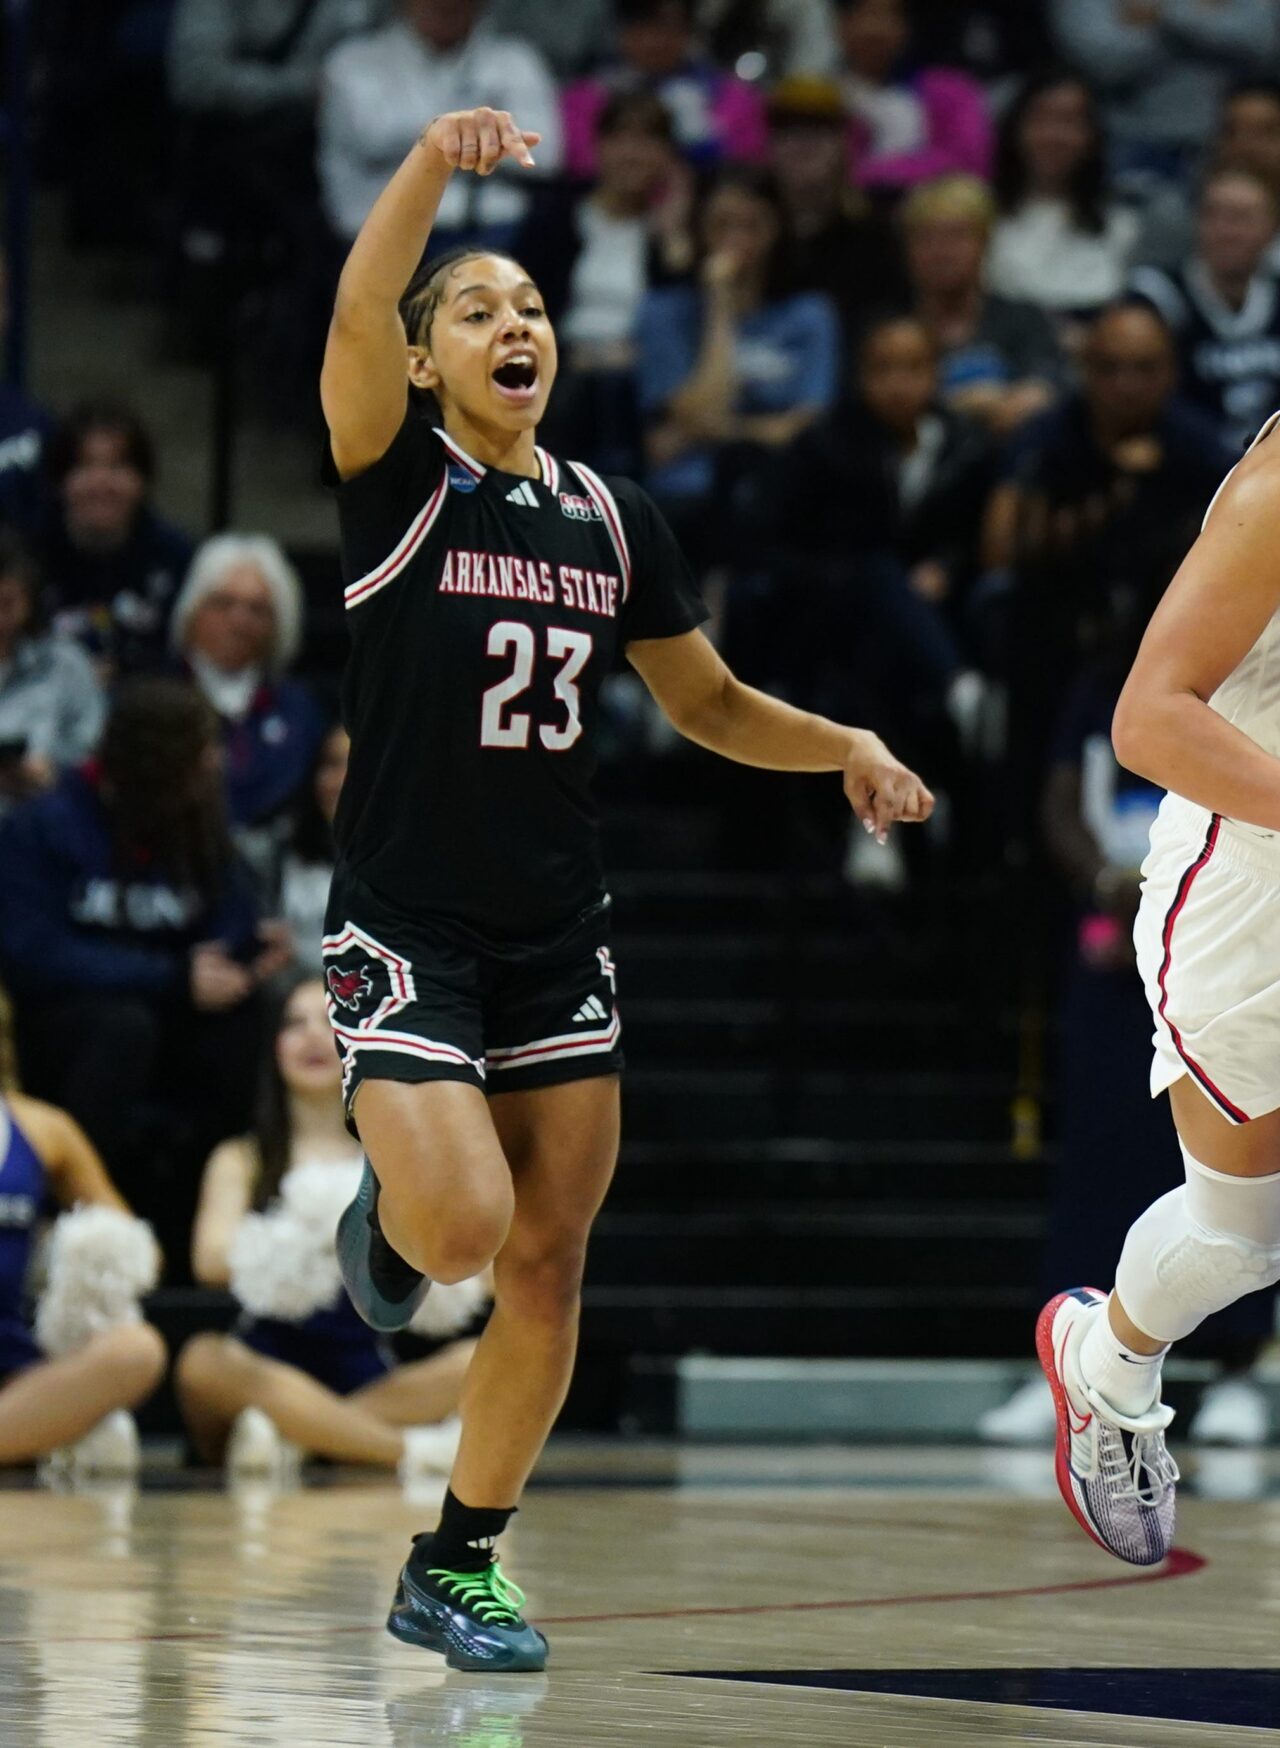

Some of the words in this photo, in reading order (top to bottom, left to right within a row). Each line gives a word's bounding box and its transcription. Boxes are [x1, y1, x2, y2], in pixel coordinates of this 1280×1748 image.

[438, 549, 556, 603] ARKANSAS
[559, 565, 619, 618] STATE
[480, 620, 593, 751] 23
